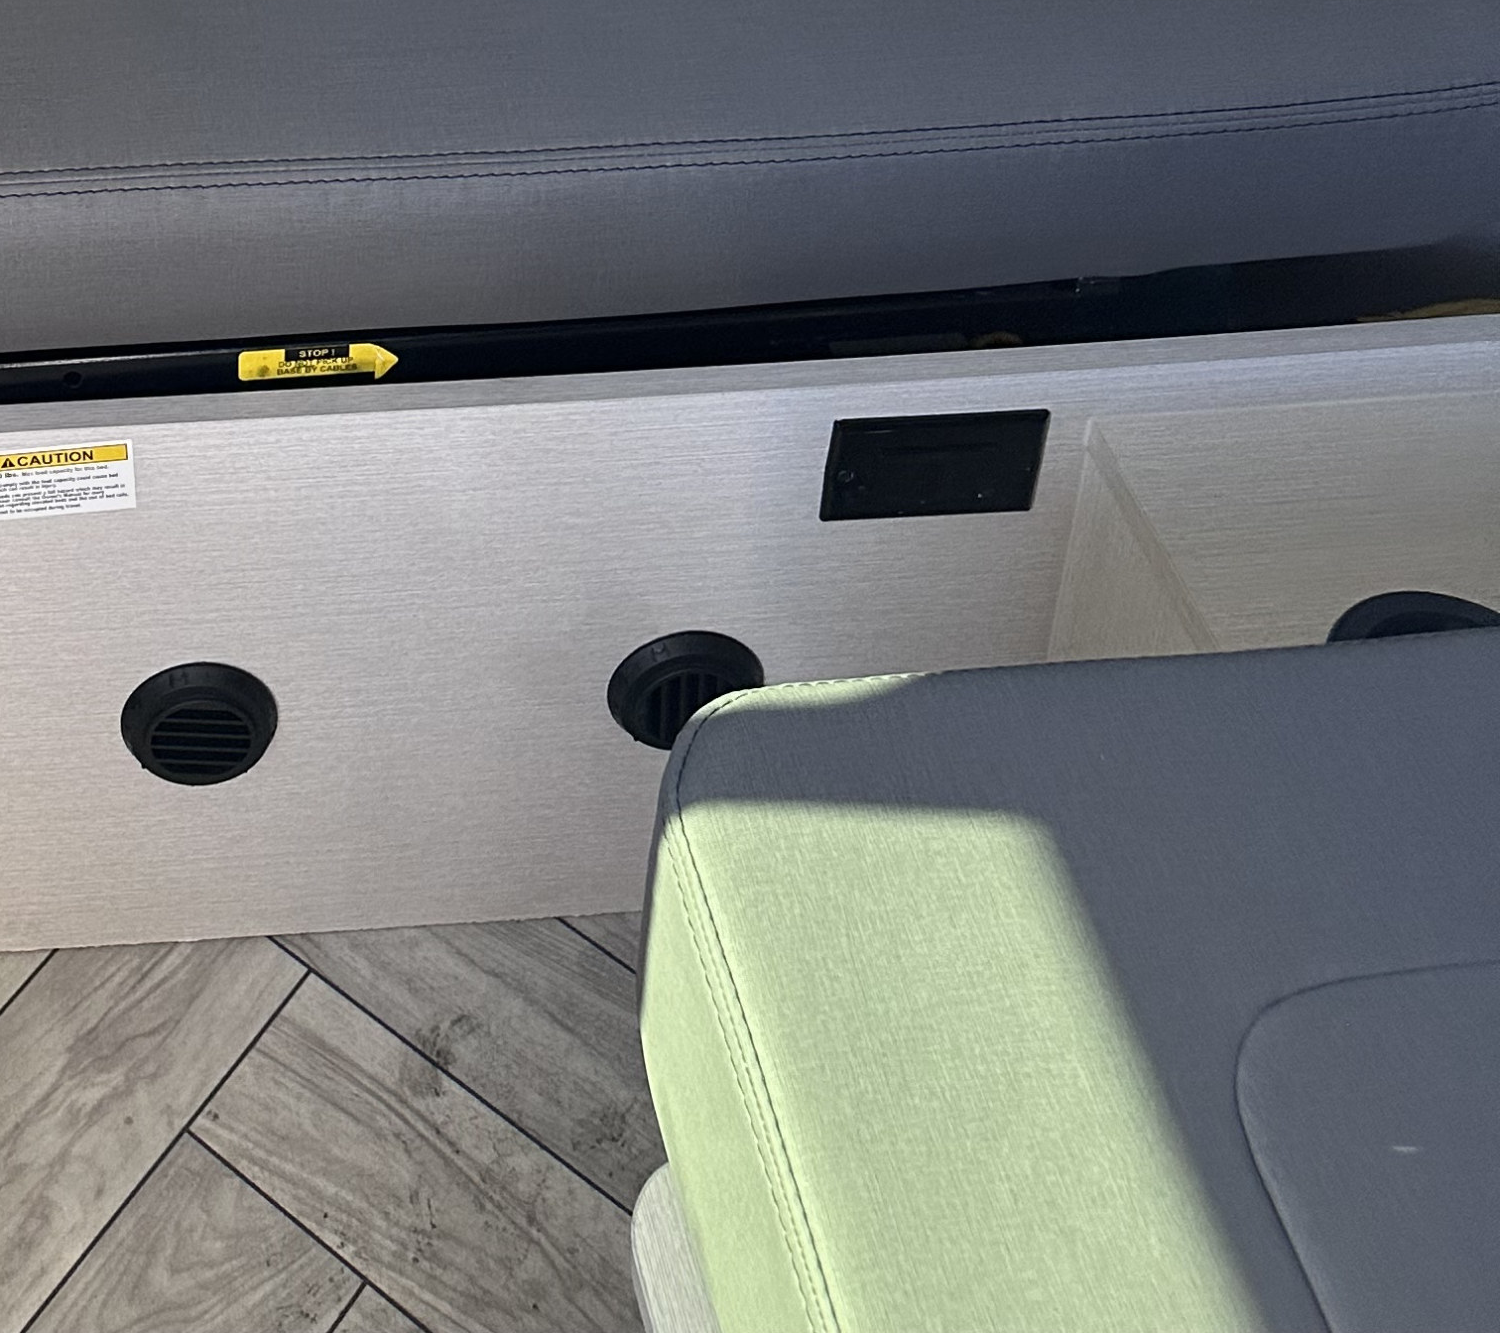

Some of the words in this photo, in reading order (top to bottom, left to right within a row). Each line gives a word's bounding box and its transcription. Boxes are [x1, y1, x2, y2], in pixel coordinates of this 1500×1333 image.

[298, 349, 328, 358] STOP
[277, 367, 302, 375] BASE
[319, 364, 357, 372] CABLES
[17, 450, 94, 467] CAUTION
